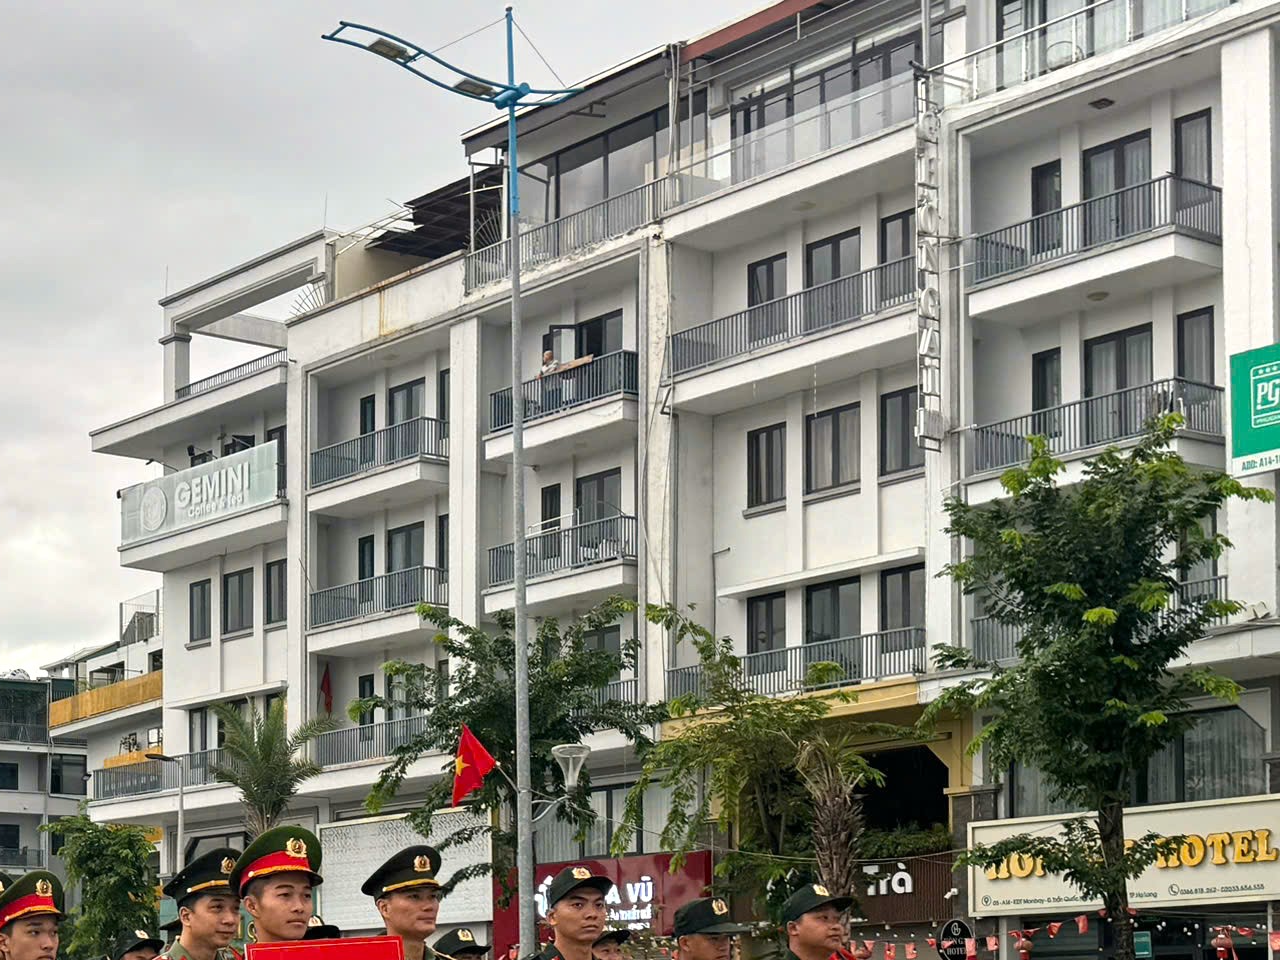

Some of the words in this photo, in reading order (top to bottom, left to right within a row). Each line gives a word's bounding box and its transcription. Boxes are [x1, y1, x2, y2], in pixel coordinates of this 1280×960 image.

[174, 461, 250, 508] GEMINI
[1154, 829, 1278, 869] HOTEL
[862, 862, 913, 896] Trà
